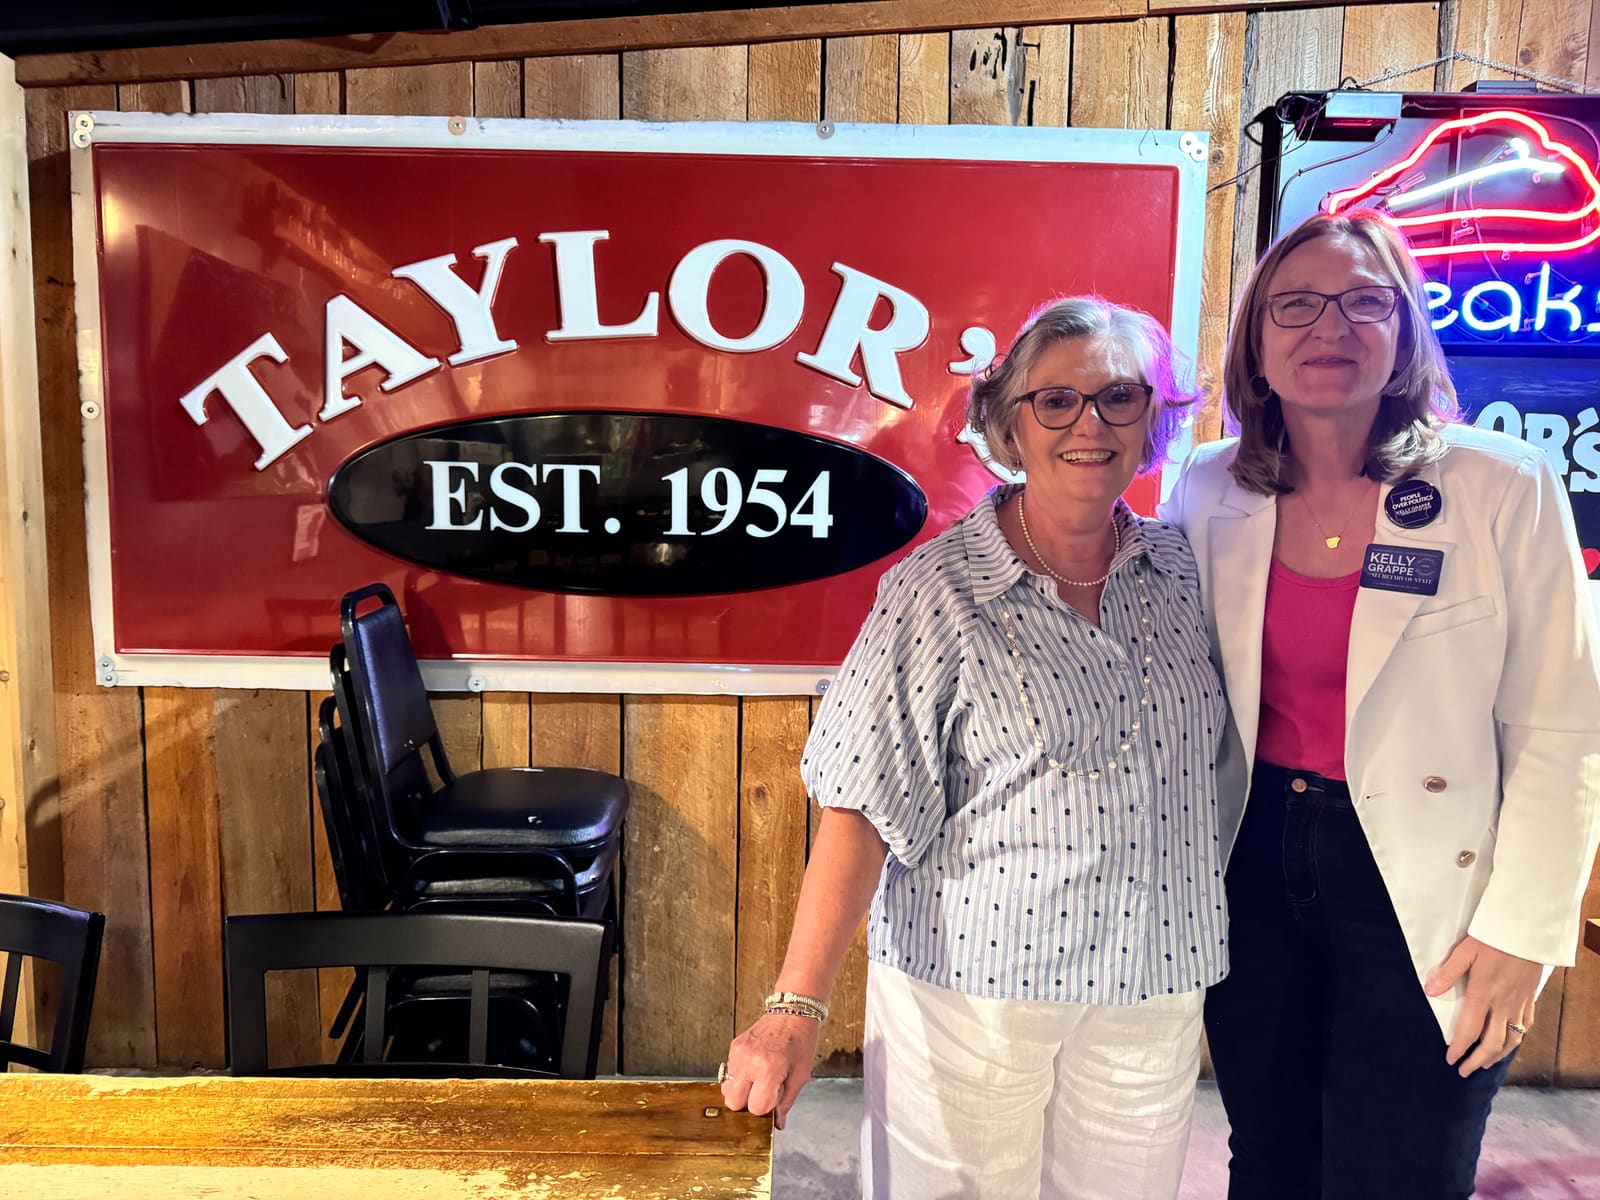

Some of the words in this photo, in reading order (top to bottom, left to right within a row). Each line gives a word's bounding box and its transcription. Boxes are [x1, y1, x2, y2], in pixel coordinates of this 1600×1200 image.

[1422, 260, 1600, 333] eak
[424, 460, 621, 535] EST.
[661, 466, 834, 539] 1954
[1392, 501, 1408, 510] OVER
[1408, 494, 1434, 505] POLITICS
[1400, 492, 1421, 501] PEOPLE
[1370, 551, 1416, 567] KELLY
[1368, 563, 1415, 577] GRAPPE
